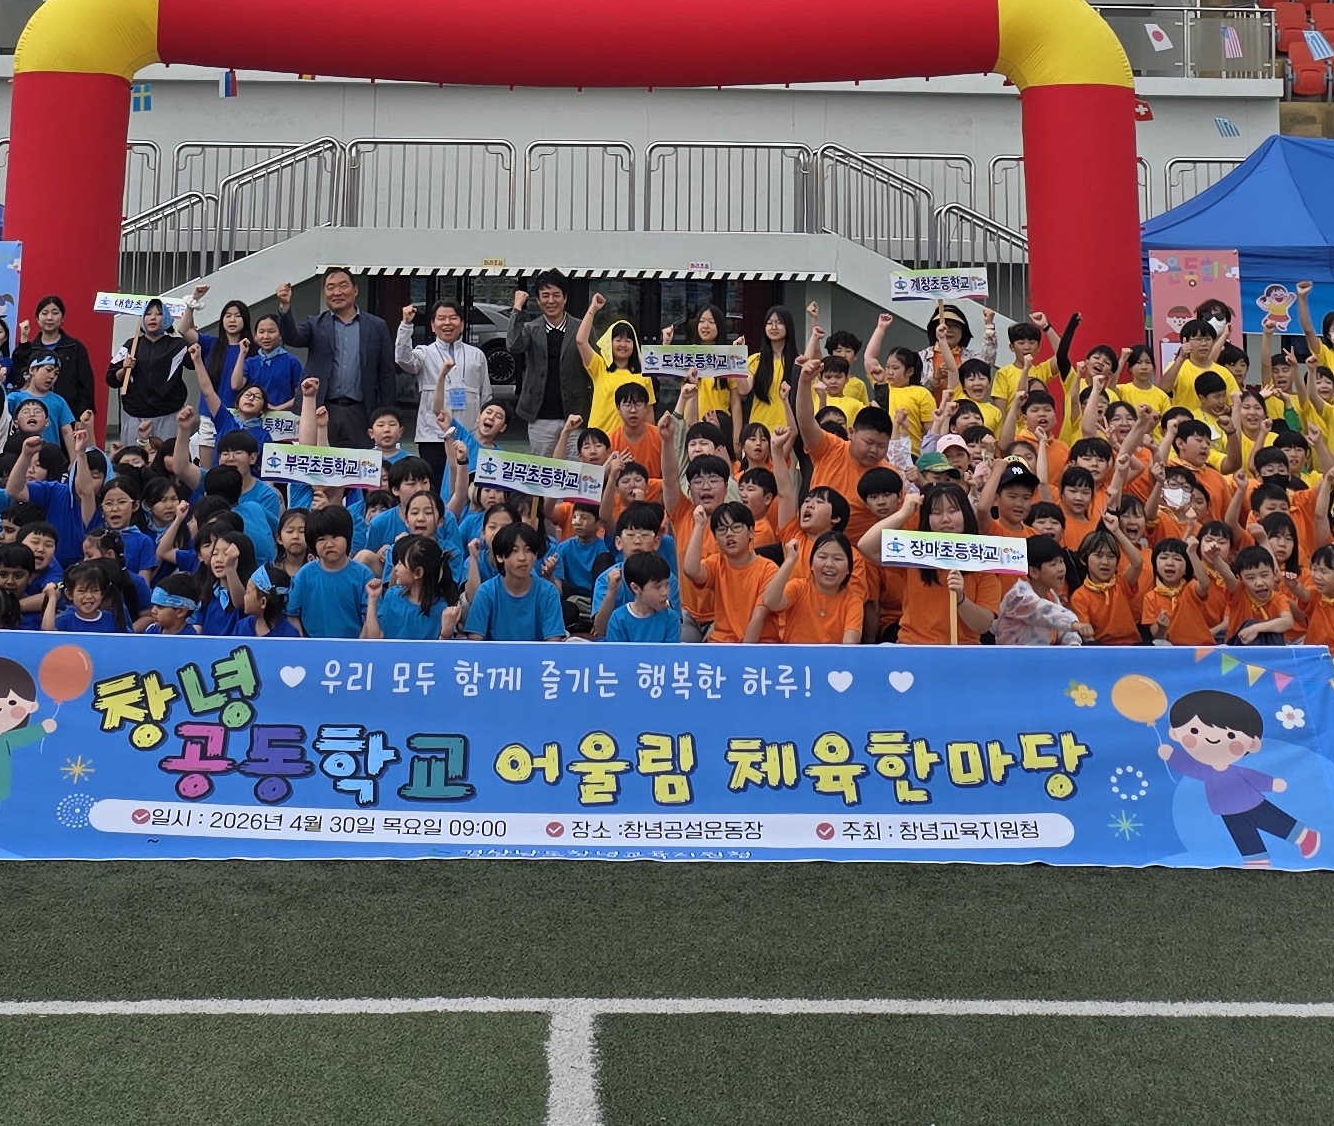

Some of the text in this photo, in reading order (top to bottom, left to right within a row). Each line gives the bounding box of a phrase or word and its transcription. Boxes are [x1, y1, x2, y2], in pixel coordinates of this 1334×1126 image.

[1167, 256, 1219, 287] 운동회
[661, 353, 727, 368] 도천초등학교
[285, 454, 358, 476] 부곡초등학교
[502, 461, 579, 488] 길곡초등학교
[910, 539, 999, 561] 장마초등학교
[321, 659, 811, 699] 우리 모두 함께 즐기는 행복한 하루!
[92, 645, 260, 750] 창녕
[158, 723, 1092, 806] 공동학교 어울림 체육한마당
[152, 808, 192, 827] 일시
[210, 811, 283, 831] 2026년
[289, 814, 322, 832] 4월
[329, 816, 375, 835] 30일
[382, 817, 442, 836] 목요일
[449, 819, 507, 837] 09:00
[571, 820, 612, 839] 장소
[842, 821, 881, 841] 주최
[899, 820, 1040, 841] 창녕교육지원청
